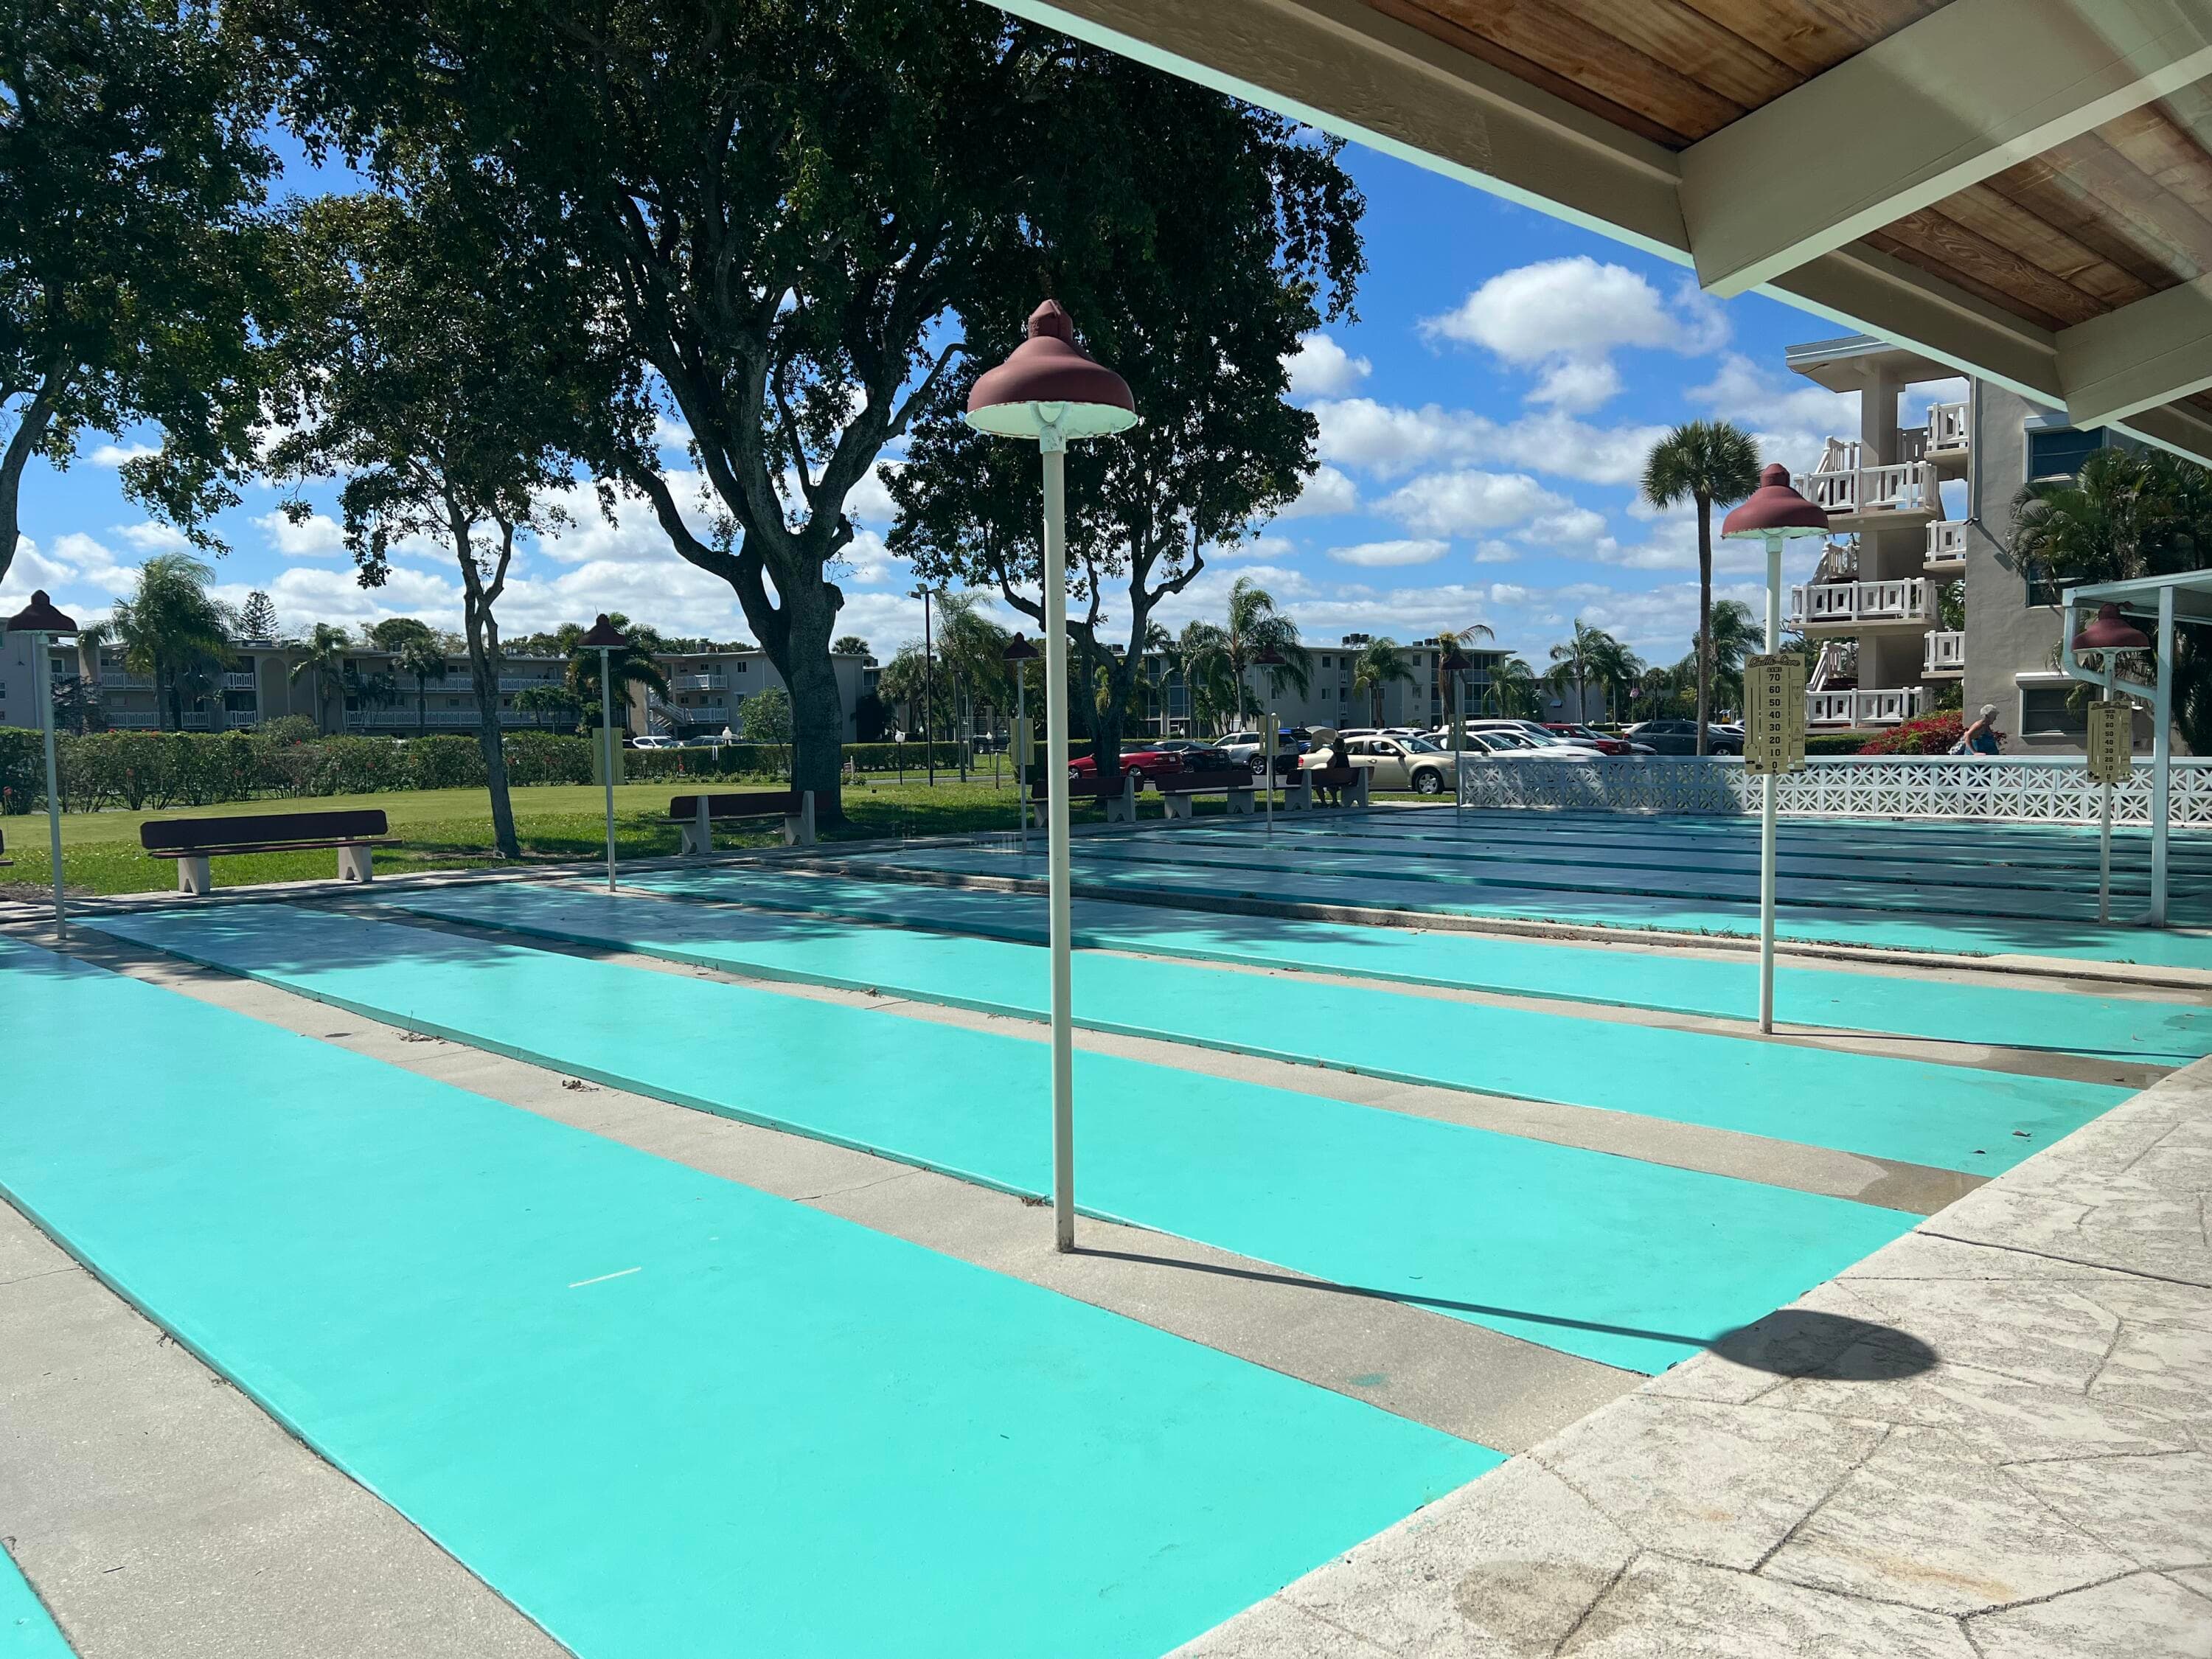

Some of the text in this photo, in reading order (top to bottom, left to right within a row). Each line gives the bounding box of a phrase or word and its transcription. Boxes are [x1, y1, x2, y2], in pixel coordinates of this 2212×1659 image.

[1769, 673, 1781, 682] 70
[1769, 685, 1781, 694] 60
[1769, 698, 1781, 707] 50
[1769, 711, 1781, 719] 40
[1769, 723, 1781, 731] 30
[1769, 736, 1781, 744] 20
[1770, 748, 1781, 757] 10
[1772, 761, 1778, 769] 0
